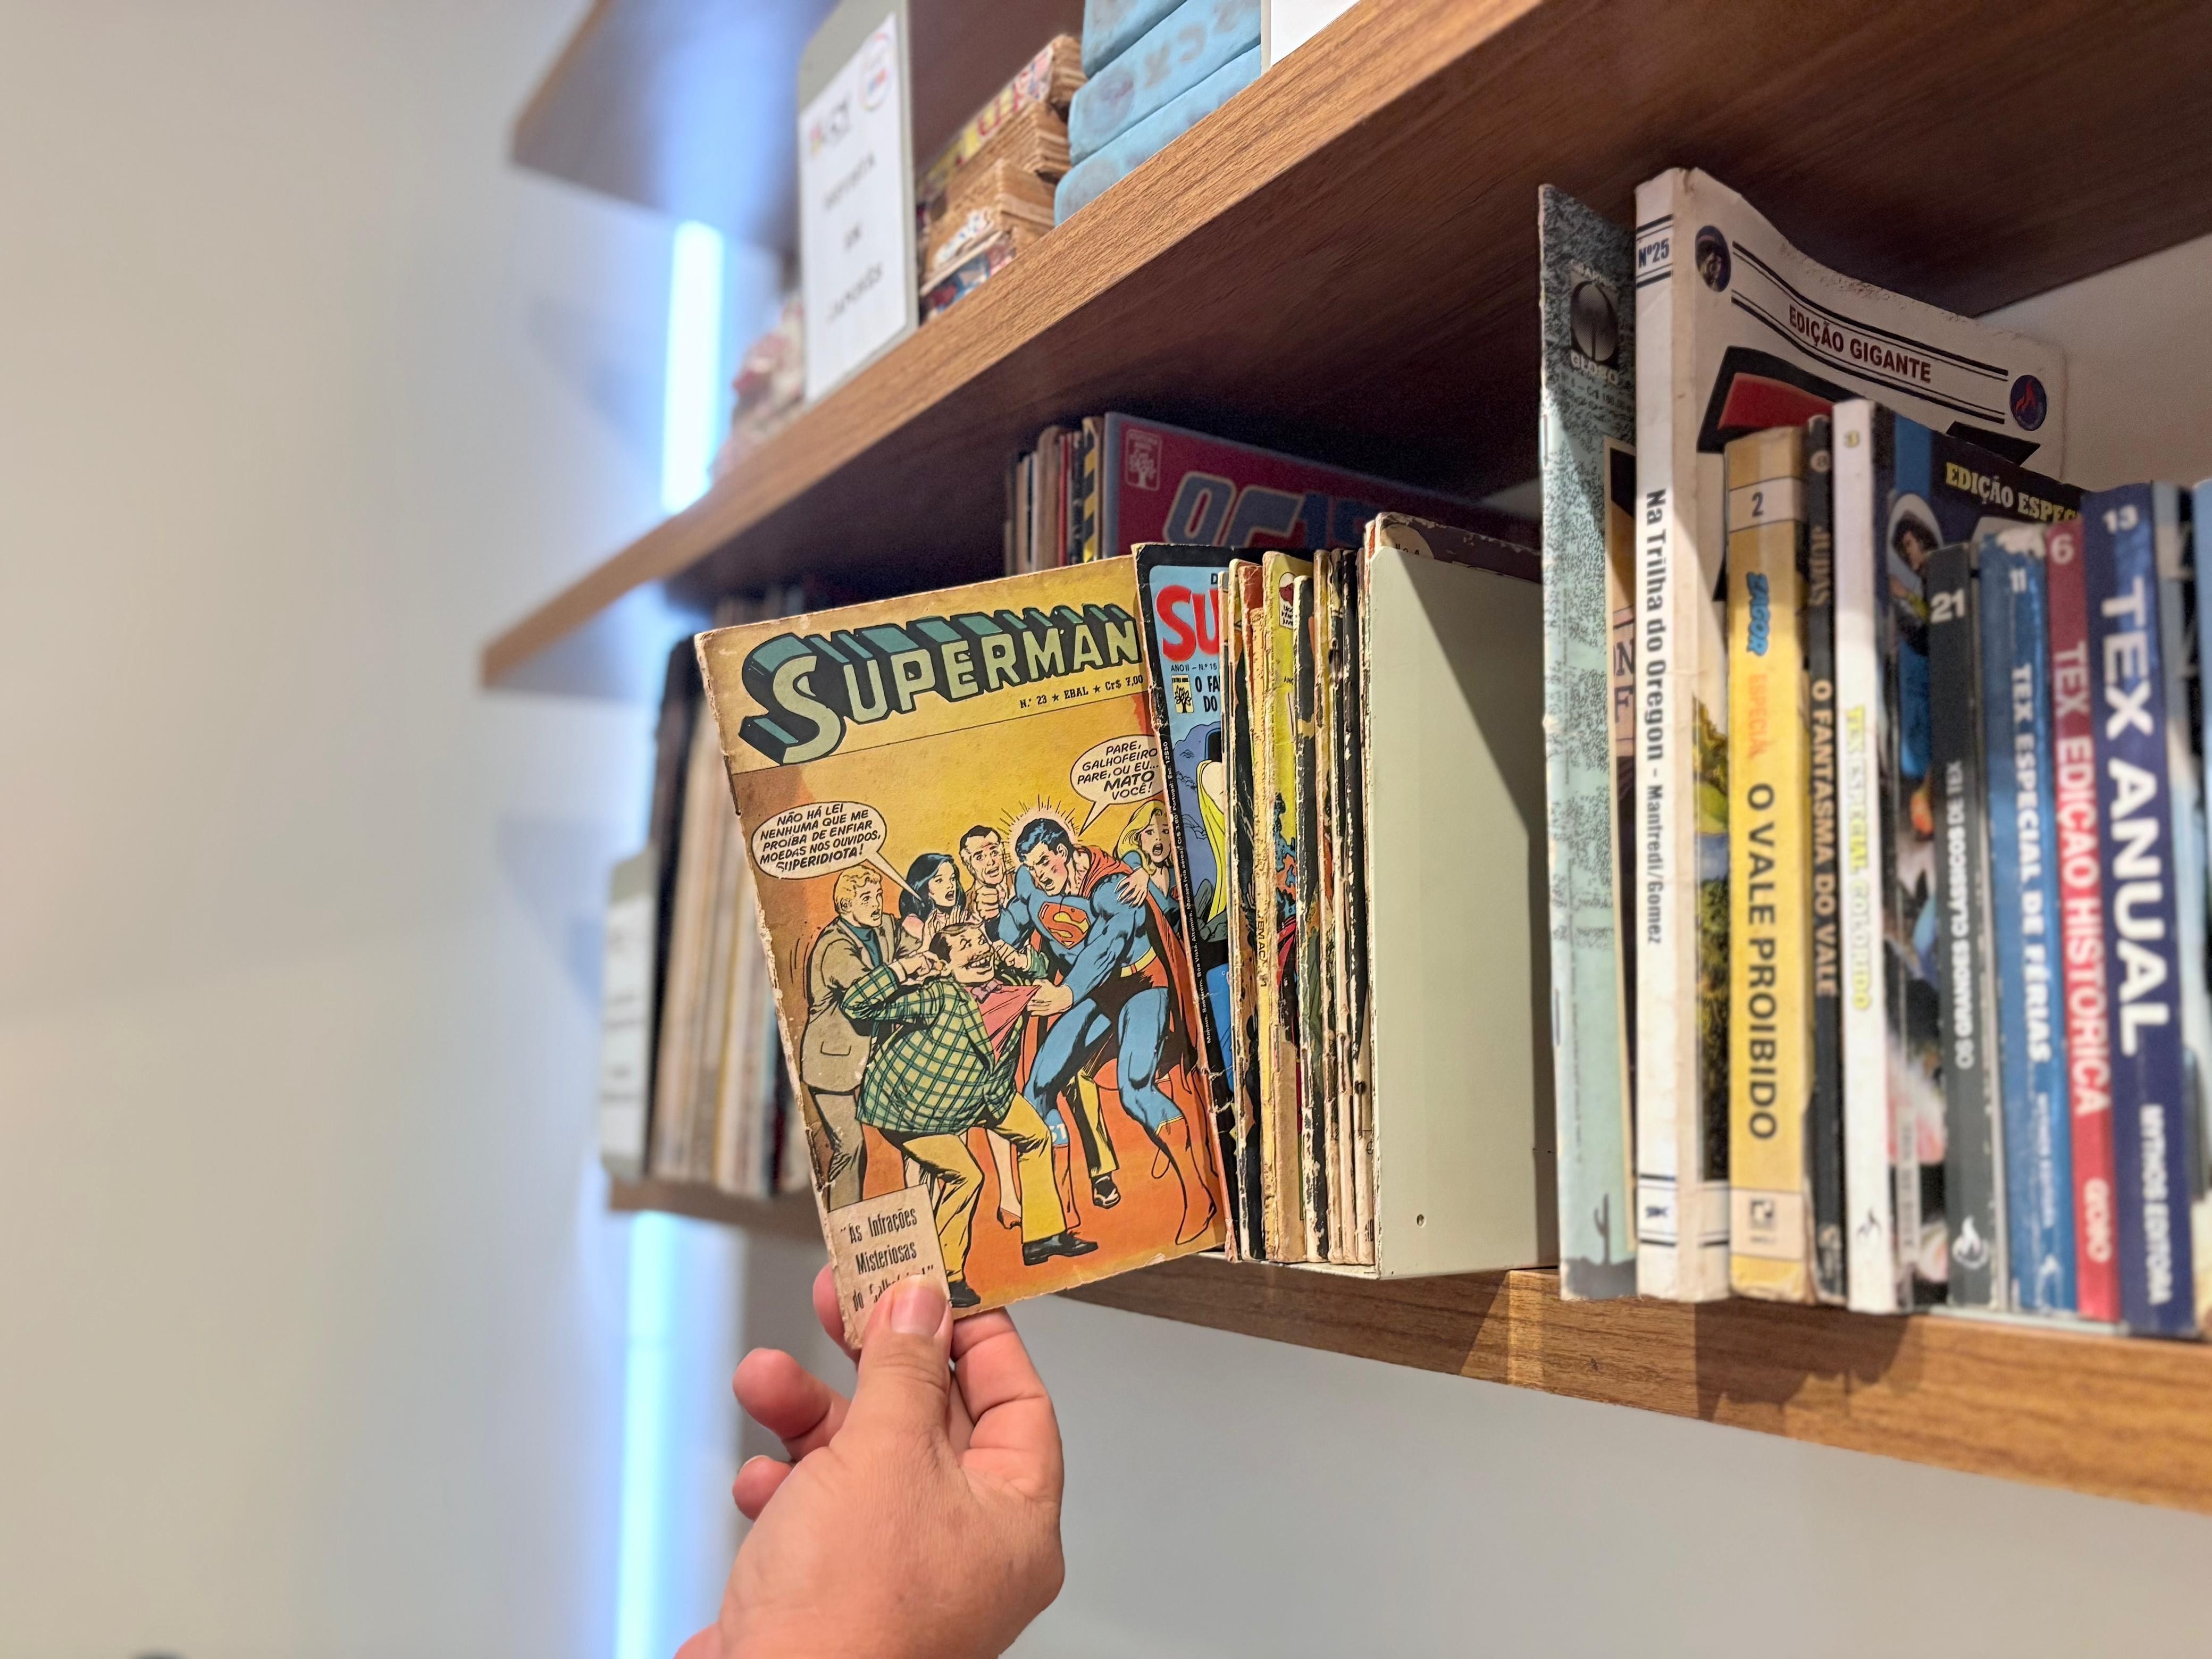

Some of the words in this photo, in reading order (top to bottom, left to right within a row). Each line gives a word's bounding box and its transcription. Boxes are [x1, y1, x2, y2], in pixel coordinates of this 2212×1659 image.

[1638, 238, 1670, 269] Nº25
[1789, 304, 1844, 352] EDIÇÃO
[1849, 338, 1931, 383] GIGANTE
[1946, 462, 2014, 508] EDIÇÃO
[1645, 489, 1666, 524] Na
[1752, 491, 1764, 517] 2
[2102, 504, 2139, 534] 13
[2050, 534, 2074, 565] 6
[1646, 528, 1667, 611] Trilha
[1746, 572, 1770, 656] ZAGOR
[1930, 588, 1965, 624] 21
[1646, 618, 1667, 652] do
[2101, 575, 2154, 740] TEX
[739, 605, 1142, 766] SUPERMAN
[1036, 695, 1048, 705] 23
[1064, 686, 1088, 700] EBAL
[1105, 678, 1121, 691] Cr$
[1125, 674, 1144, 686] 7,00
[1195, 676, 1202, 692] O
[1207, 675, 1220, 692] FA
[1812, 680, 1832, 701] O
[2012, 663, 2033, 725] TEX
[2052, 641, 2090, 717] TEX
[1203, 695, 1218, 713] DO
[1644, 660, 1667, 760] Oregon
[1082, 748, 1158, 771] GALHOFEIRO
[1106, 740, 1142, 756] PARE,
[1077, 770, 1111, 785] PARE,
[1113, 765, 1130, 776] OU
[1134, 760, 1159, 772] EU...
[1103, 770, 1155, 792] MATO
[1812, 710, 1836, 864] FANTASMA
[1945, 760, 1964, 795] TEX
[1112, 782, 1153, 800] VOCÊ!
[1748, 783, 1774, 811] O
[2014, 734, 2041, 881] ESPECIAL
[760, 820, 818, 840] NENHUMA
[823, 814, 847, 826] QUE
[851, 810, 869, 821] ME
[777, 811, 803, 826] NÃO
[807, 806, 823, 820] HÁ
[825, 803, 844, 815] LEI
[1947, 798, 1965, 823] DE
[760, 846, 807, 865] MOEDAS
[809, 841, 830, 854] NOS
[833, 830, 881, 848] OUVIDOS,
[812, 830, 827, 842] DE
[830, 820, 873, 837] ENFIAR
[776, 844, 864, 873] SUPERIDIOTA!
[1646, 784, 1665, 945] Manfredi/Gomez
[1747, 822, 1775, 925] VALE
[1814, 875, 1837, 916] DO
[2022, 890, 2044, 934] DE
[2108, 758, 2169, 1056] ANUAL
[1815, 924, 1838, 996] VALE
[1850, 882, 1872, 1010] COLORIDO
[1952, 941, 1973, 1036] GRANDES
[2023, 943, 2052, 1063] FÉRIAS
[1748, 938, 1778, 1140] PROIBIDO
[1956, 1041, 1974, 1069] OS
[868, 1208, 917, 1237] Infrações
[855, 1242, 917, 1275] Misteriosas
[852, 1289, 864, 1312] do
